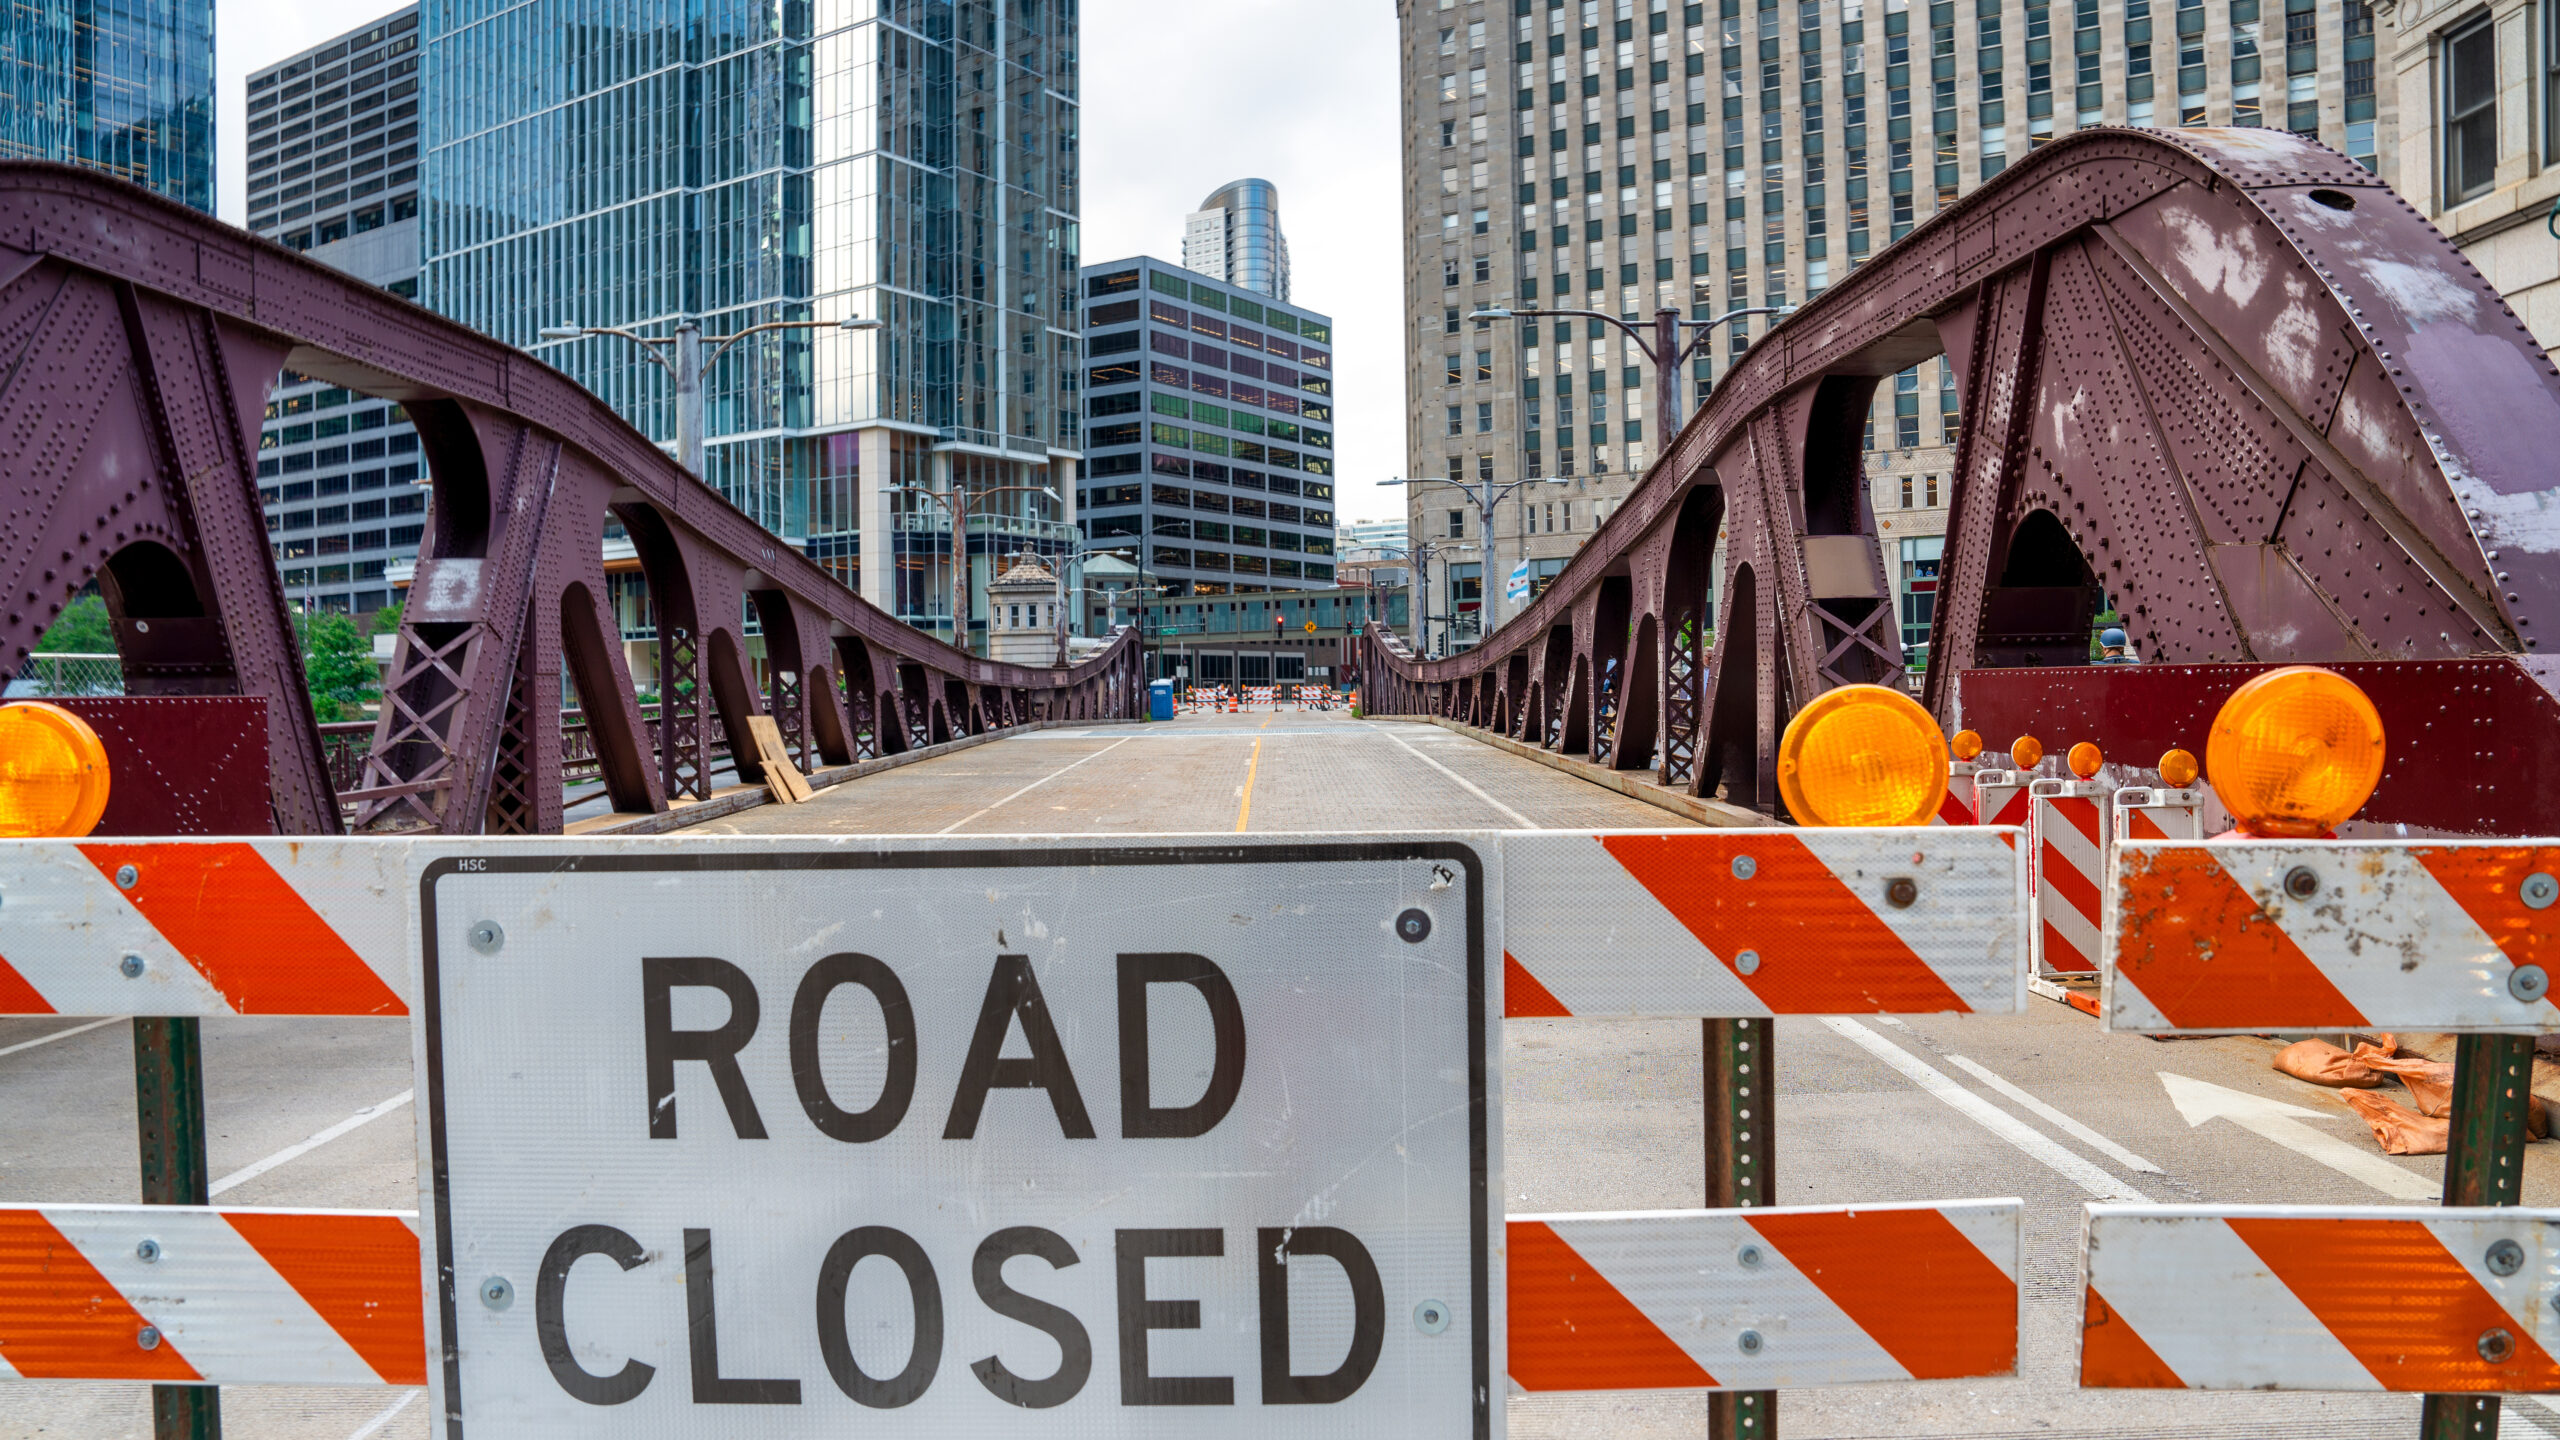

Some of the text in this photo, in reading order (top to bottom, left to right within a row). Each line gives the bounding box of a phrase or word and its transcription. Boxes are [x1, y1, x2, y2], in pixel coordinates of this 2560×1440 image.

[458, 858, 487, 871] HSC
[640, 952, 1247, 1144] ROAD
[535, 1223, 1386, 1409] CLOSED
